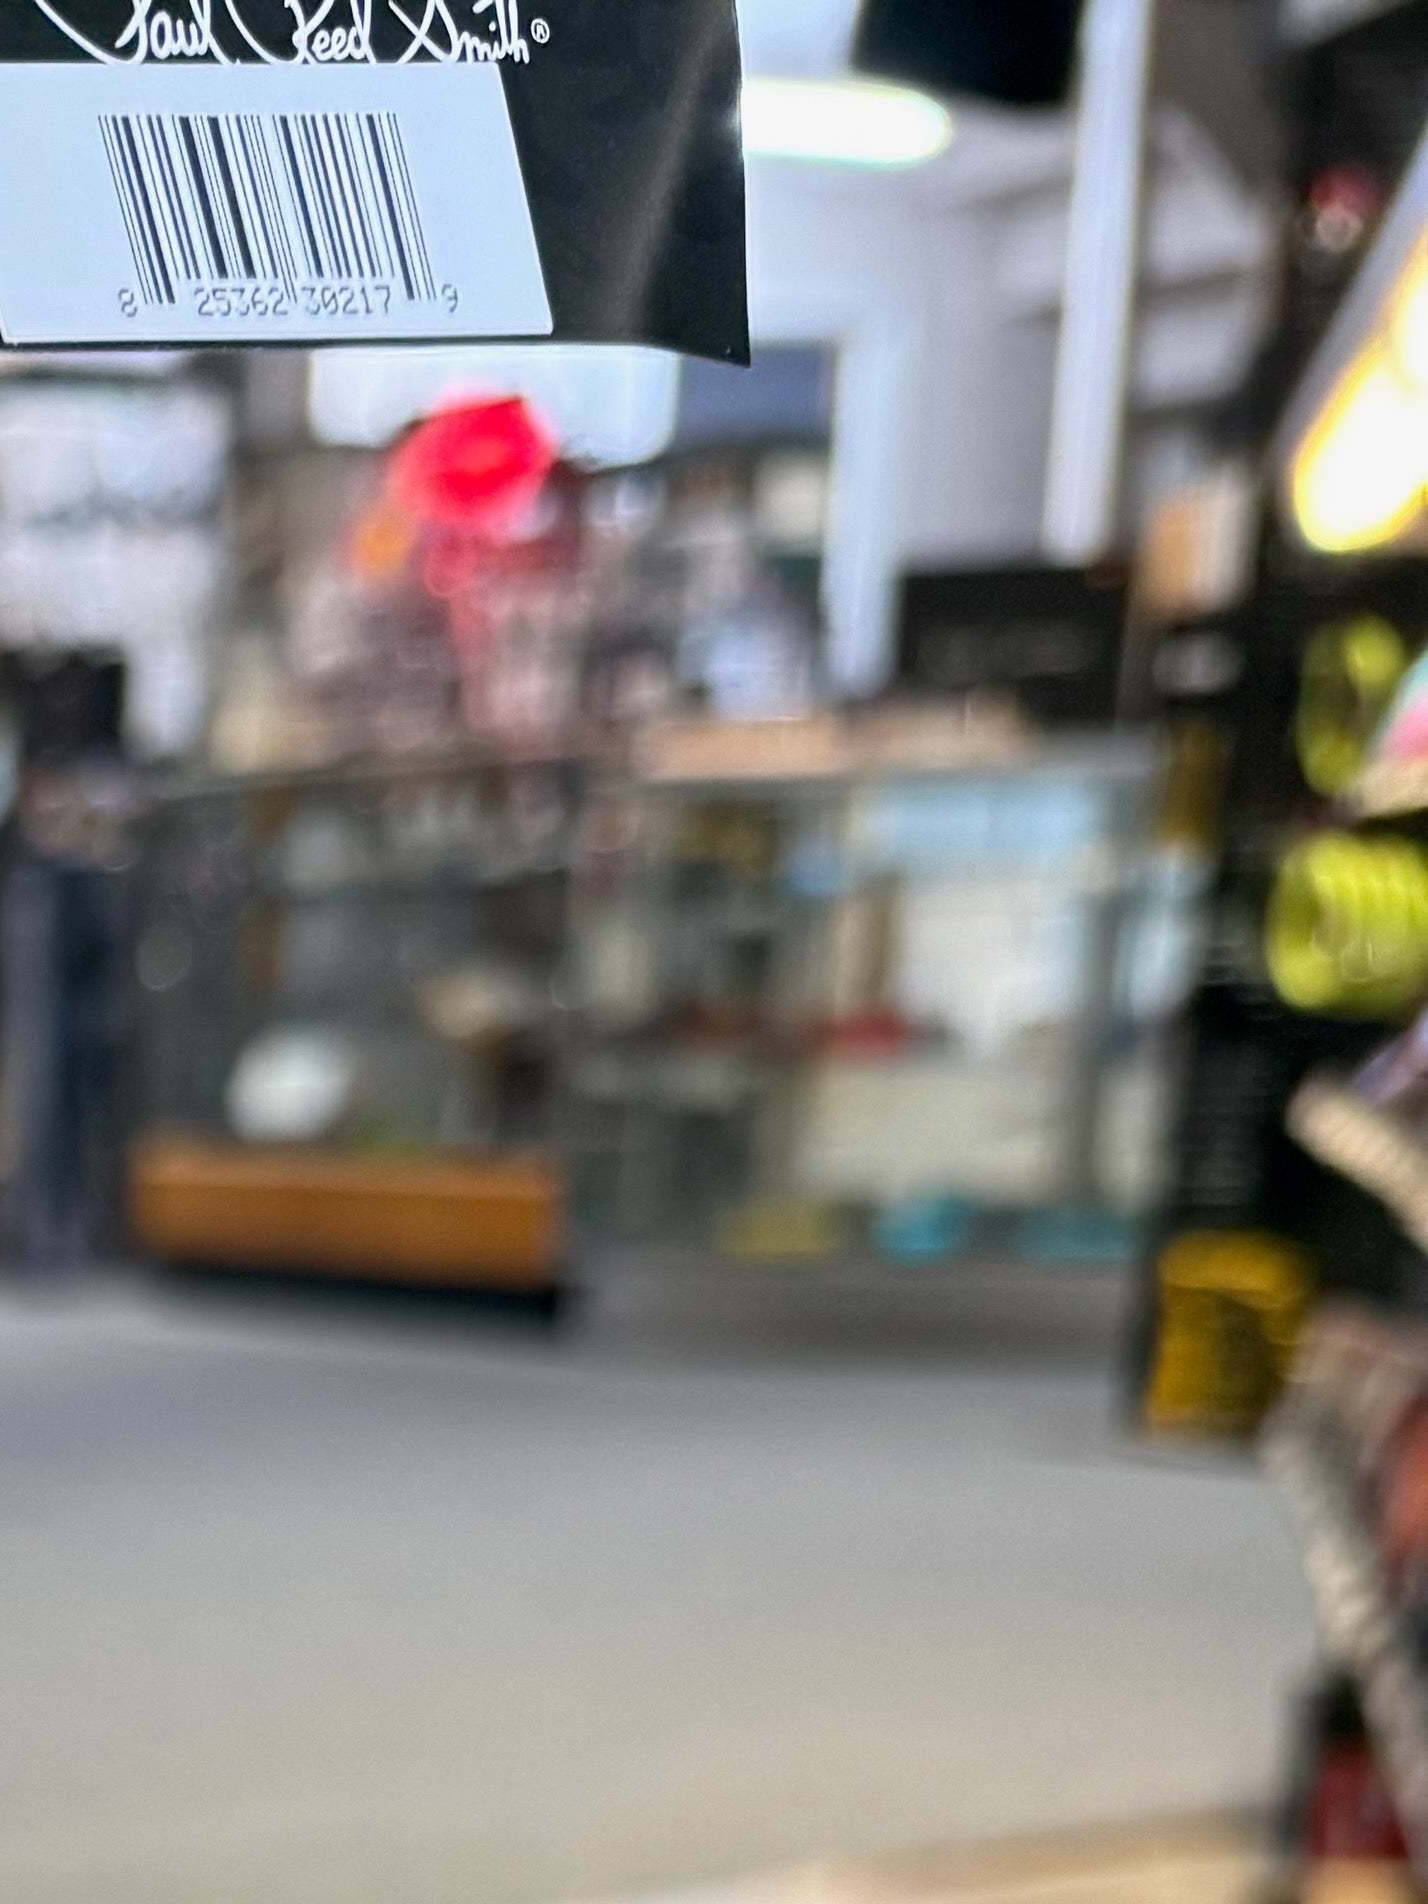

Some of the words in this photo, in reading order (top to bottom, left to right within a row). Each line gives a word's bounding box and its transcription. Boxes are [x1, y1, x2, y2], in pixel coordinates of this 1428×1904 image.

[118, 287, 138, 318] 8
[193, 286, 290, 317] 25362
[300, 284, 392, 316] 30217
[441, 282, 459, 314] 9
